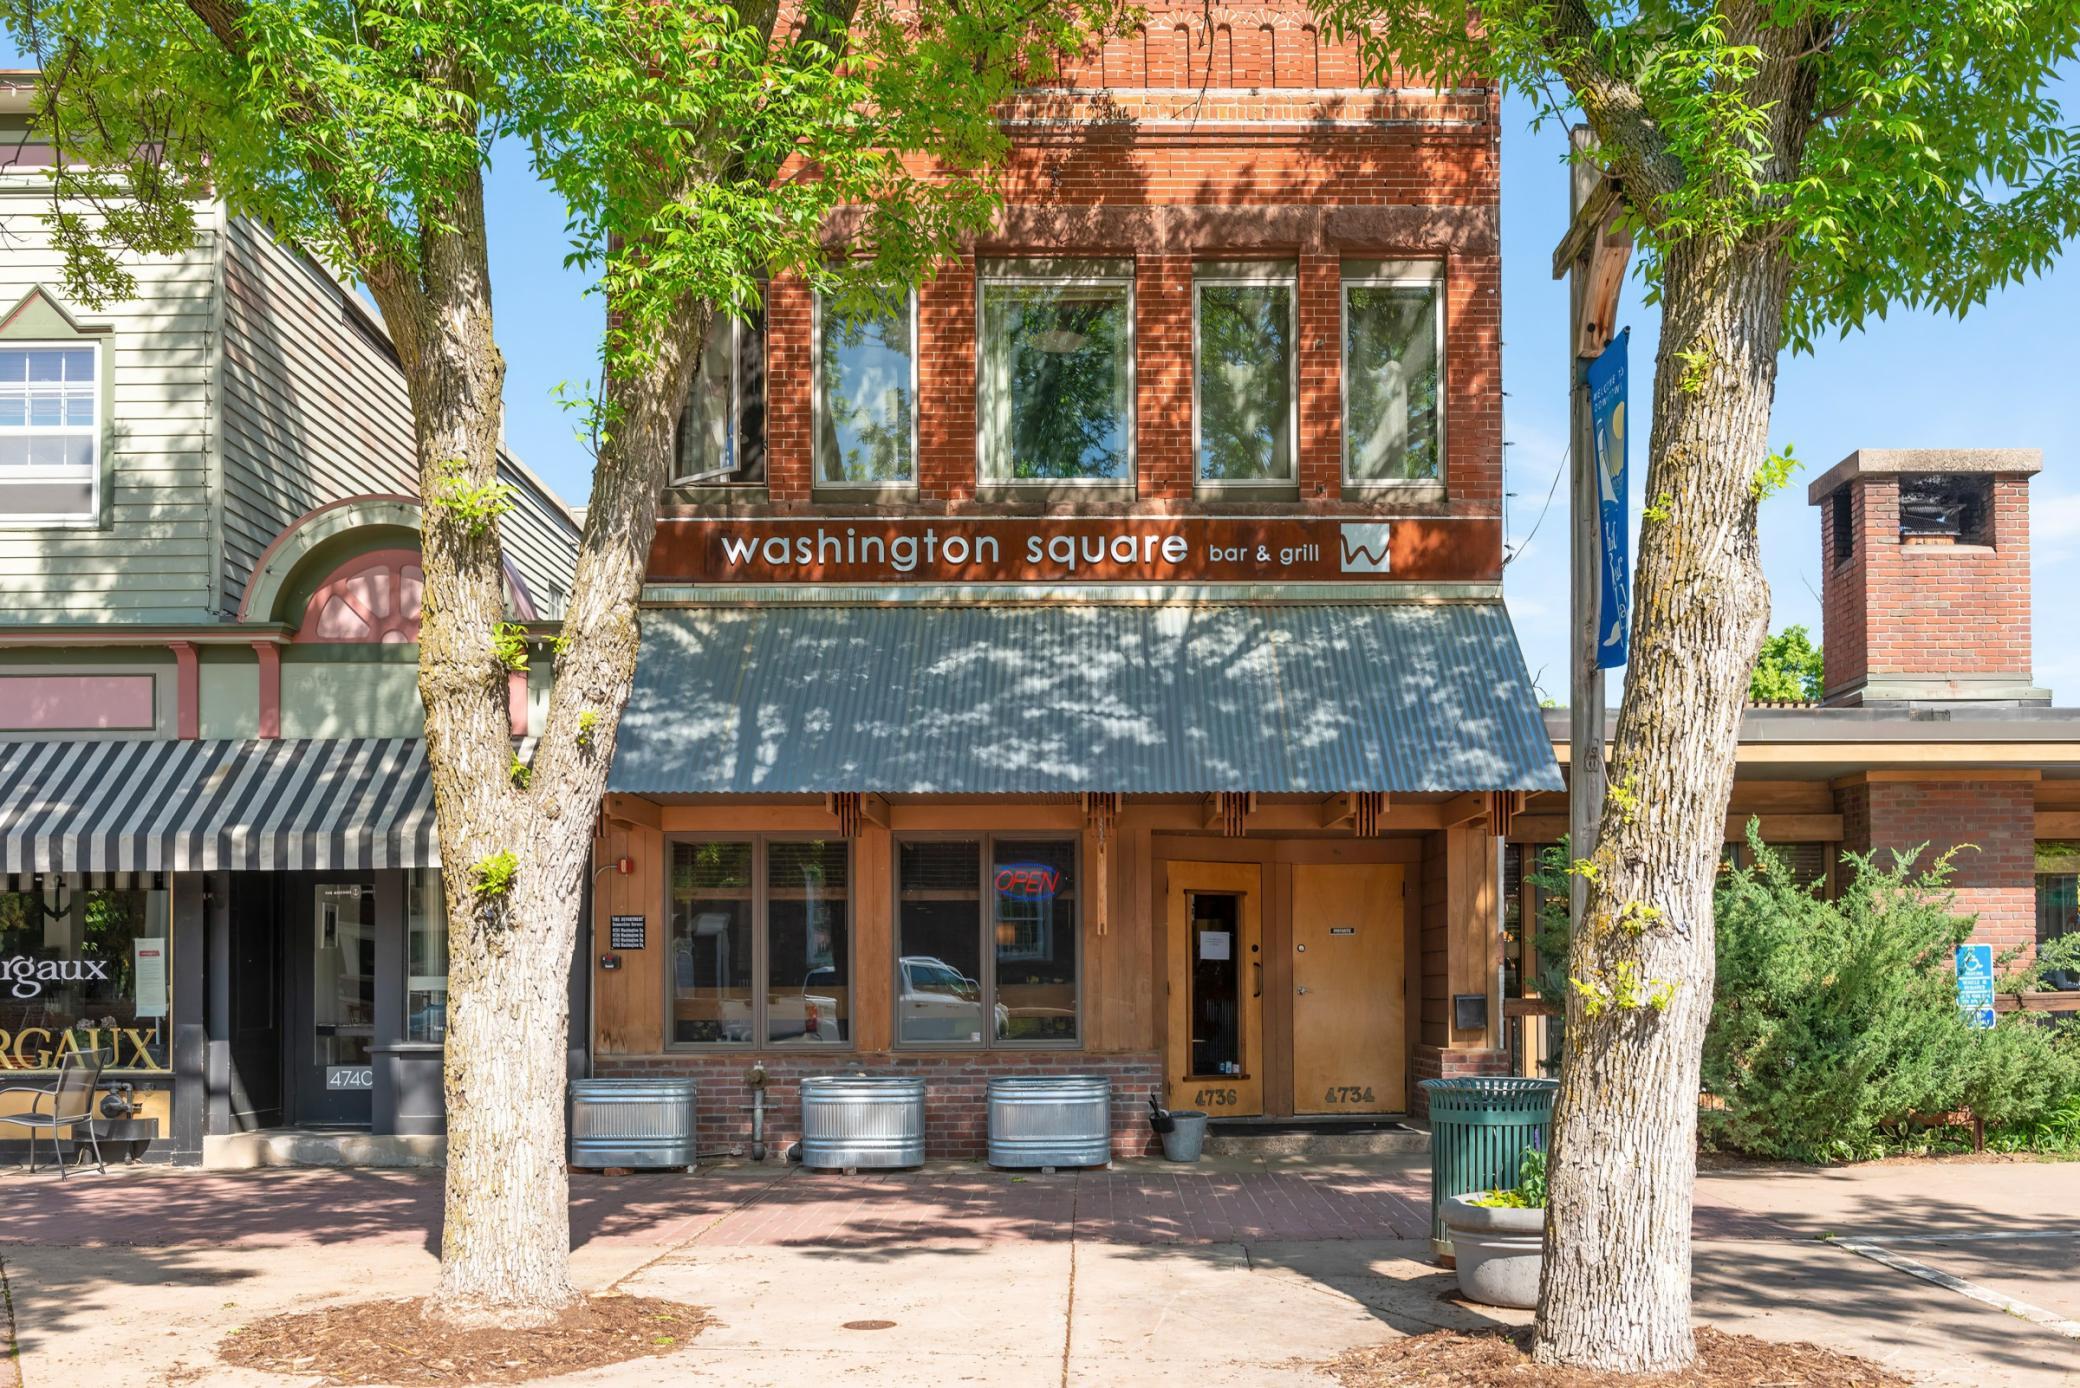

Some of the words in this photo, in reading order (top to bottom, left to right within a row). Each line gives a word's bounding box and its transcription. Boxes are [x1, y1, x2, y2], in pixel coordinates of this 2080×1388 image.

[721, 528, 998, 572] washington
[1026, 535, 1188, 570] square
[1209, 544, 1247, 562] bar
[1256, 545, 1271, 562] &
[1280, 543, 1319, 564] grill
[995, 870, 1060, 894] OPEN
[329, 1070, 373, 1087] 4740
[1195, 1088, 1238, 1106] 4736
[1325, 1086, 1375, 1104] 4734
